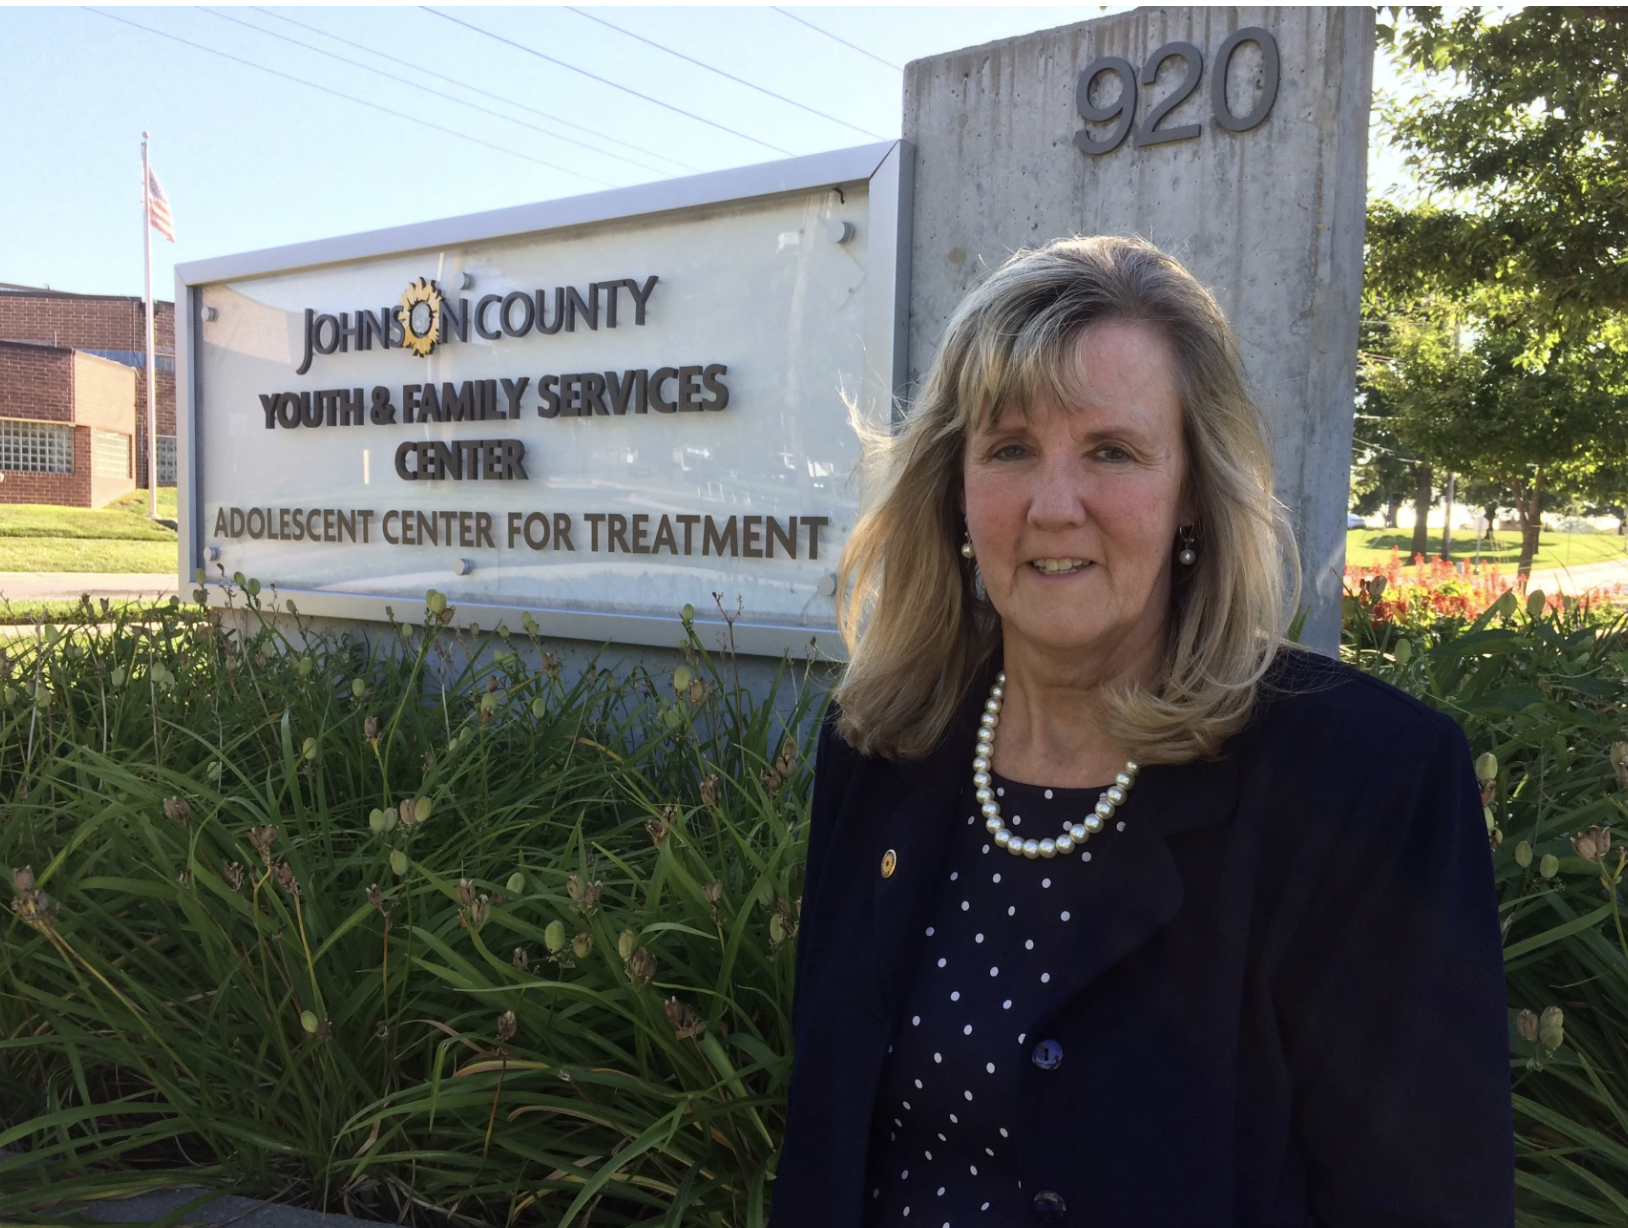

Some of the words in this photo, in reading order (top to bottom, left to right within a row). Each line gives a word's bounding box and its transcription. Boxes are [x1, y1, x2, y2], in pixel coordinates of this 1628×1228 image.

[1075, 26, 1280, 155] 920
[296, 290, 469, 374] JOHNSON
[475, 276, 659, 341] COUNTY
[259, 387, 364, 429] YOUTH
[370, 386, 396, 425] &
[403, 376, 529, 423] FAMILY
[537, 364, 729, 418] SERVICES
[395, 439, 529, 481] CENTER
[214, 506, 374, 544] ADOLESCENT
[382, 509, 495, 549] CENTER
[507, 511, 576, 552] FOR
[584, 512, 829, 561] TREATMENT
